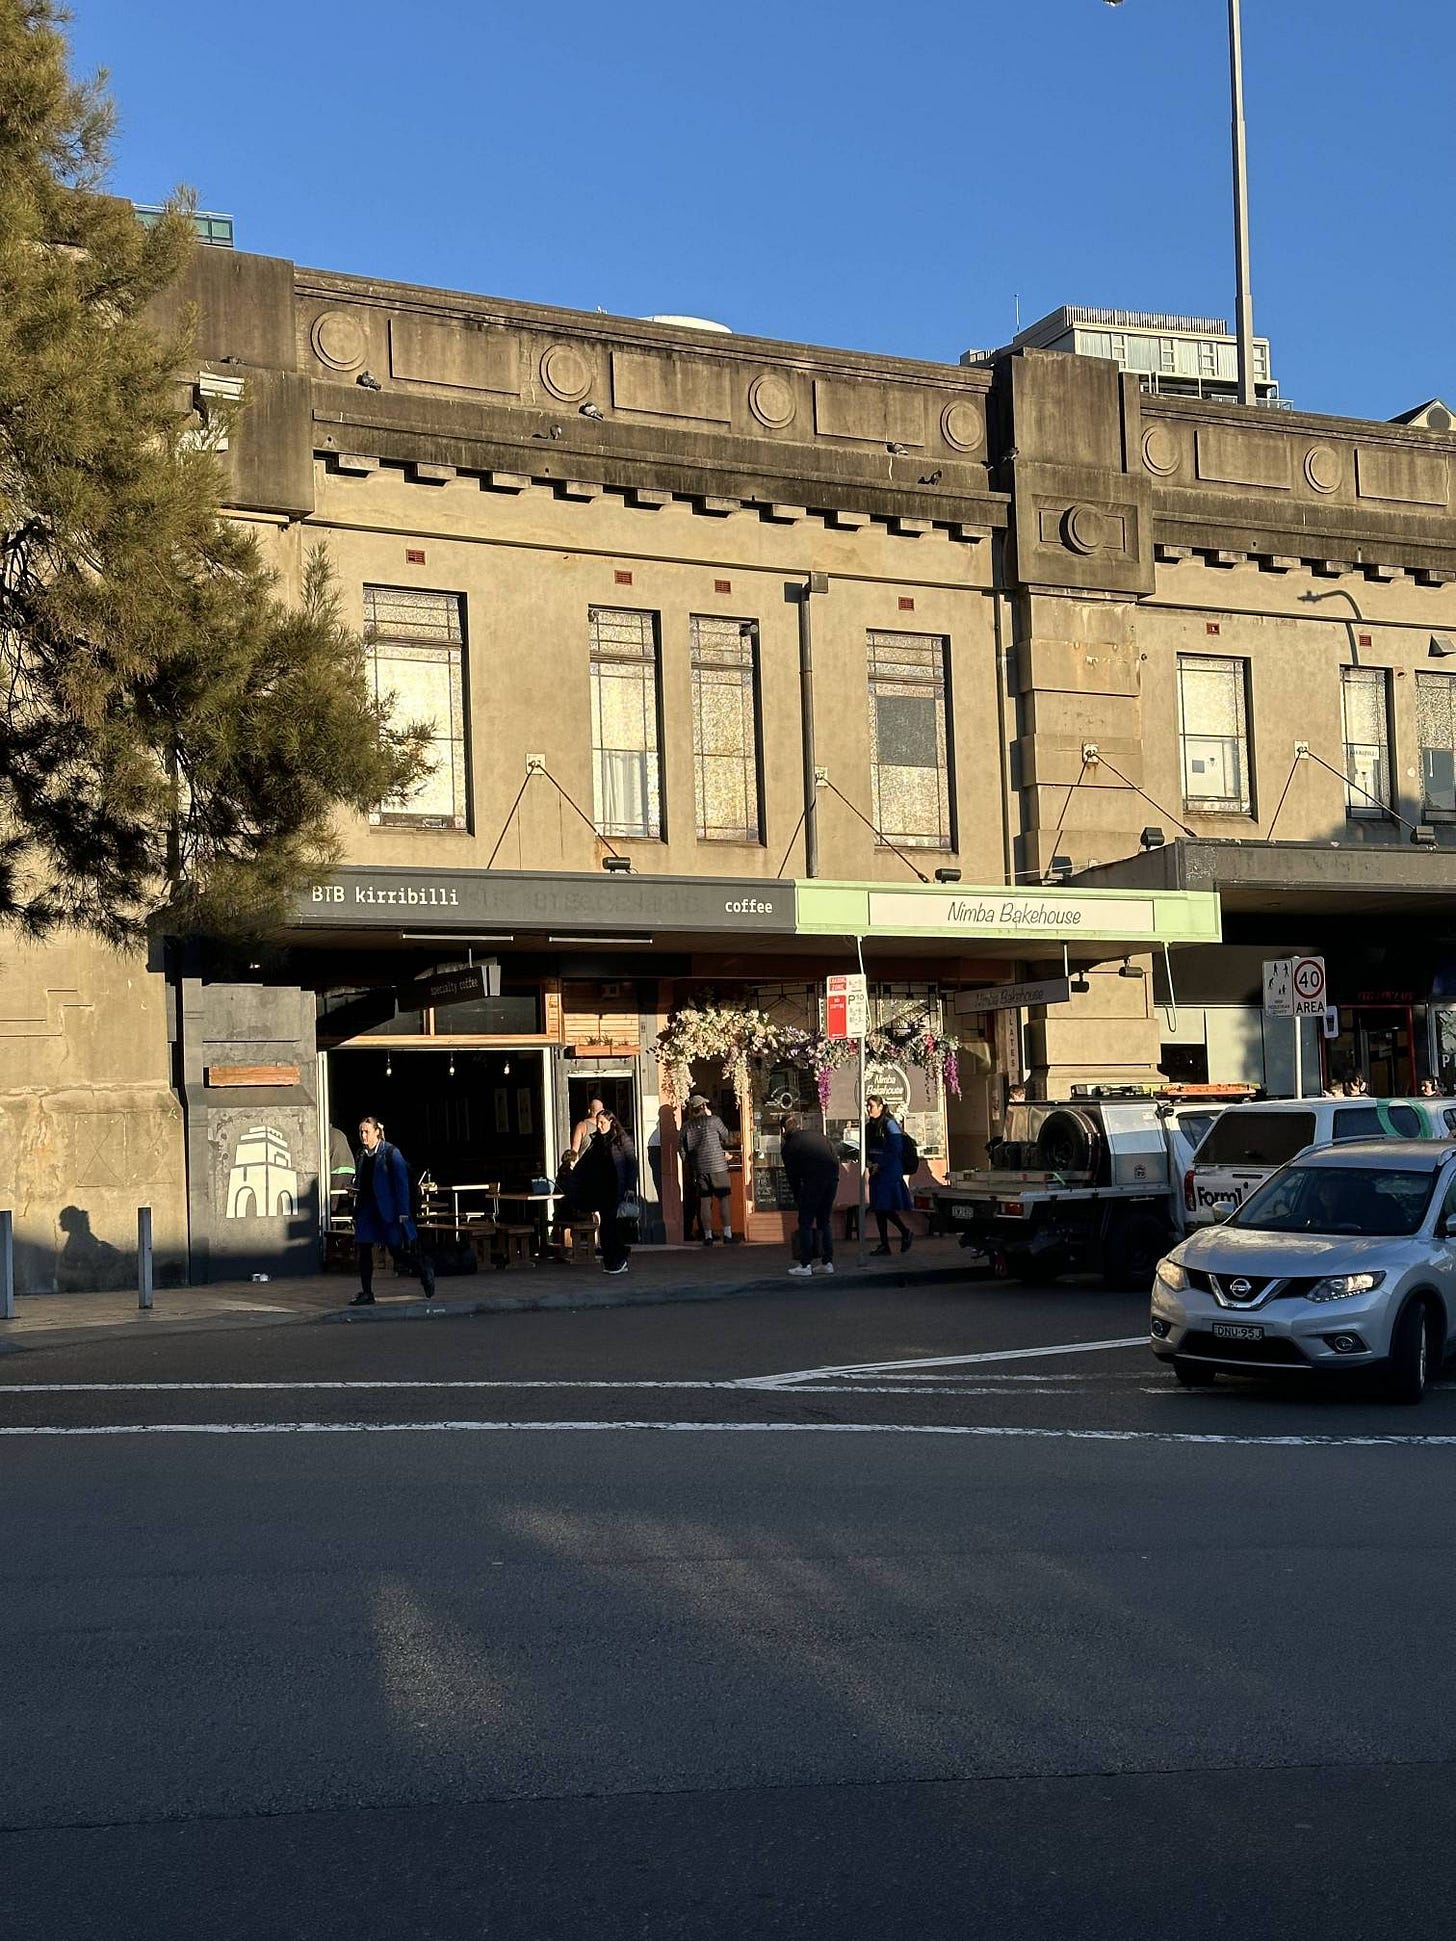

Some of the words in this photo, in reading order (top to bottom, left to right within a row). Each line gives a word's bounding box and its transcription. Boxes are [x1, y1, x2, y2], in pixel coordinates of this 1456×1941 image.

[312, 886, 345, 903] BTB
[355, 887, 459, 905] kirribilli
[724, 899, 773, 914] coffee
[947, 901, 995, 923] Nimba
[999, 902, 1082, 925] Bakehouse
[430, 982, 457, 996] specialty
[459, 976, 479, 990] coffee
[1298, 971, 1320, 988] 40
[1296, 1001, 1325, 1014] AREA
[874, 1074, 896, 1084] Nimba
[866, 1084, 904, 1096] Bakehouse
